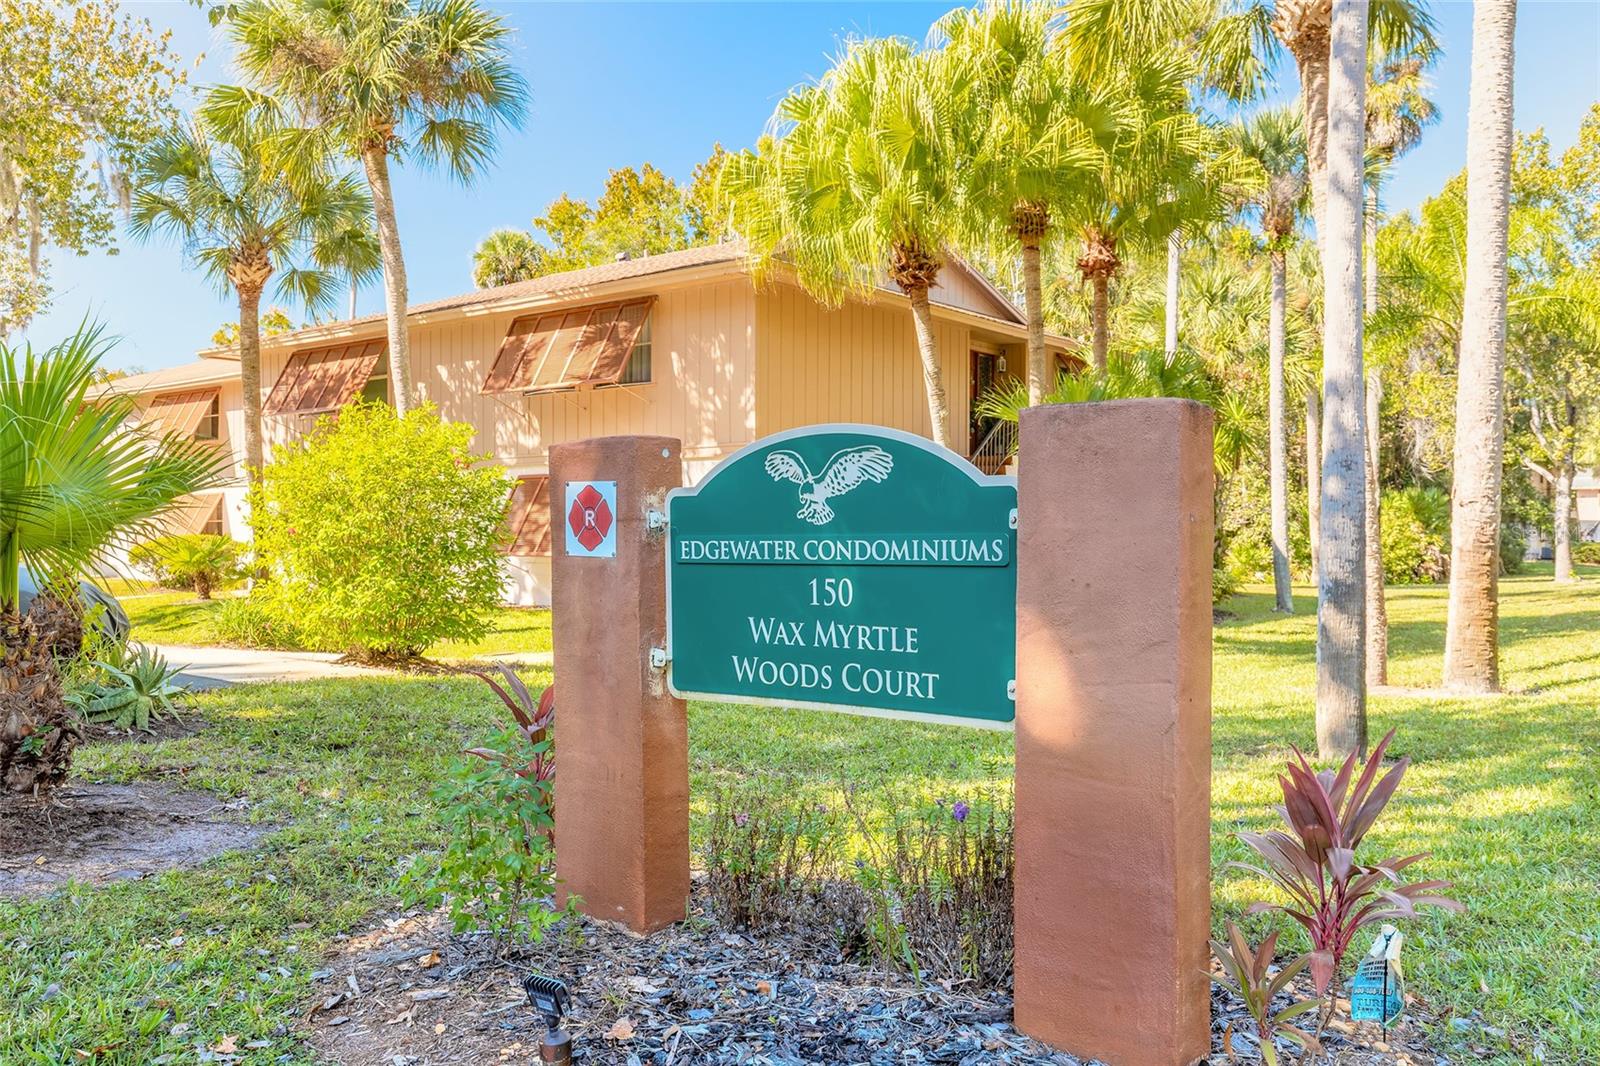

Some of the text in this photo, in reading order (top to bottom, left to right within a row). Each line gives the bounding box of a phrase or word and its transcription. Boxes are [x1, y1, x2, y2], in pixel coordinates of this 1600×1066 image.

[585, 510, 596, 527] R
[680, 539, 1003, 562] EDGEWATER CONDOMINIUMS
[809, 577, 853, 607] 150
[748, 616, 919, 654] WAX MYRTLE
[731, 655, 940, 699] WOODS COURT
